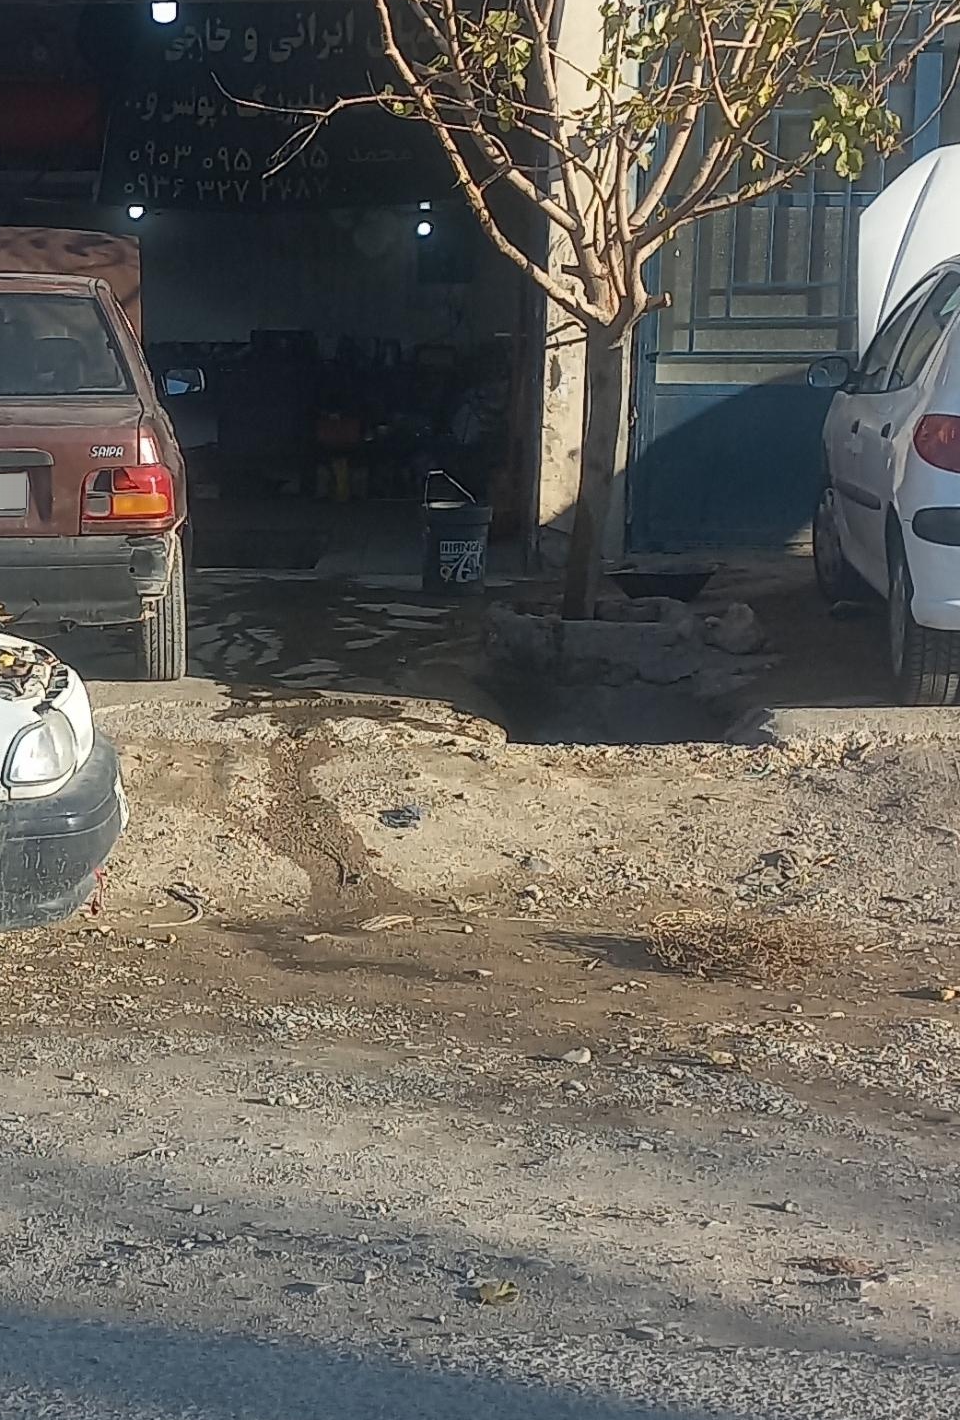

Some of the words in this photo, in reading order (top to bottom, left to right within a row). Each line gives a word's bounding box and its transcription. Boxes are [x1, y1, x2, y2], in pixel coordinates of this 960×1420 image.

[242, 27, 258, 63] و
[269, 7, 355, 63] ایرانی
[129, 140, 192, 169] ۰۹۰۳
[203, 146, 252, 171] ۰۹۵
[196, 180, 250, 202] ۳۲۷
[90, 444, 125, 458] SAIPA
